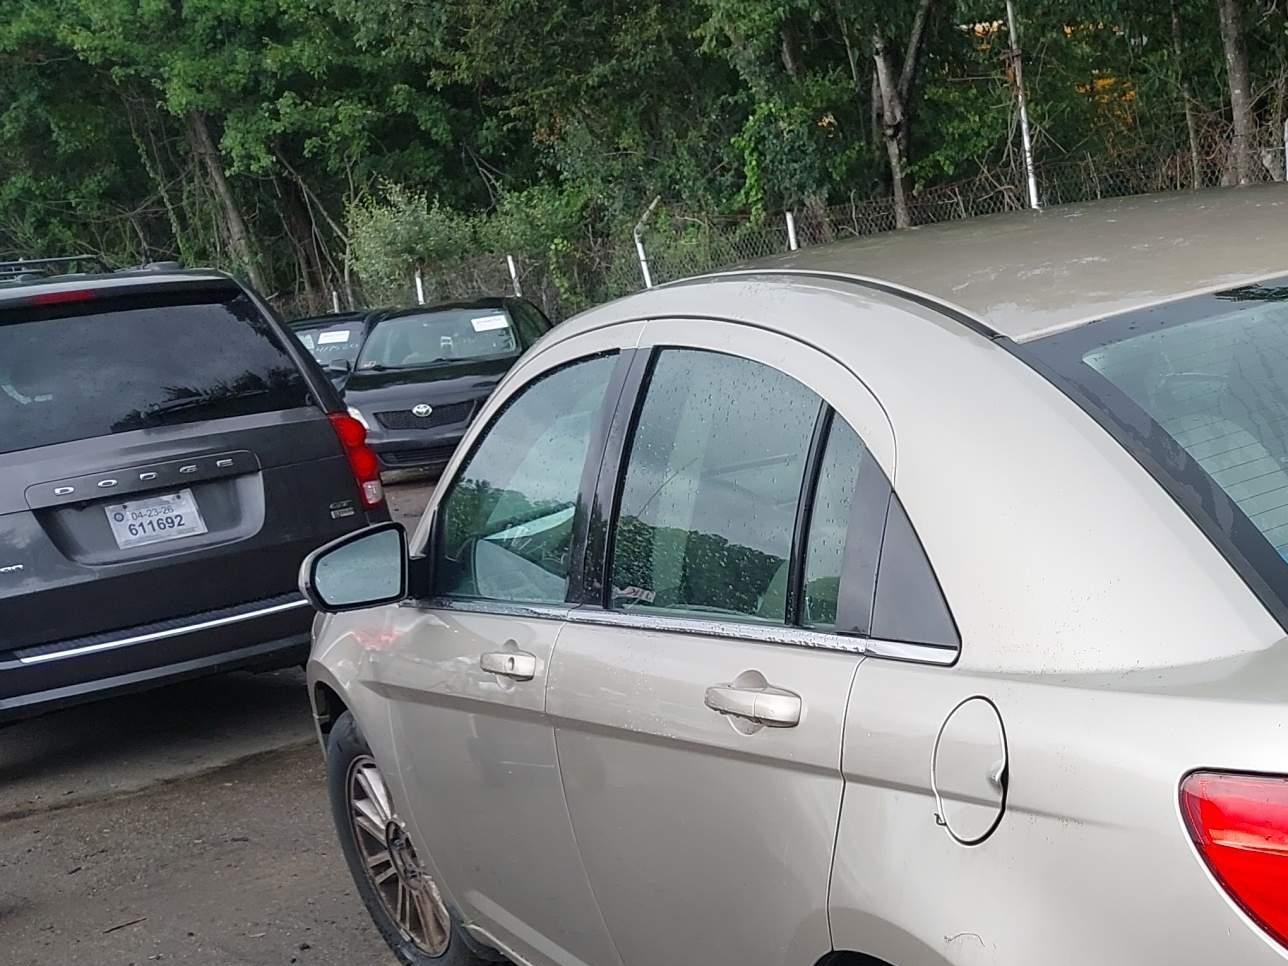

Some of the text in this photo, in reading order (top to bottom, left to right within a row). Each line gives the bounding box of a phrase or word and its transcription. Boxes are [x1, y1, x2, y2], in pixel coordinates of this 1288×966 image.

[54, 458, 233, 496] DODGE
[131, 504, 175, 521] 04-23-26
[127, 514, 186, 537] 611692
